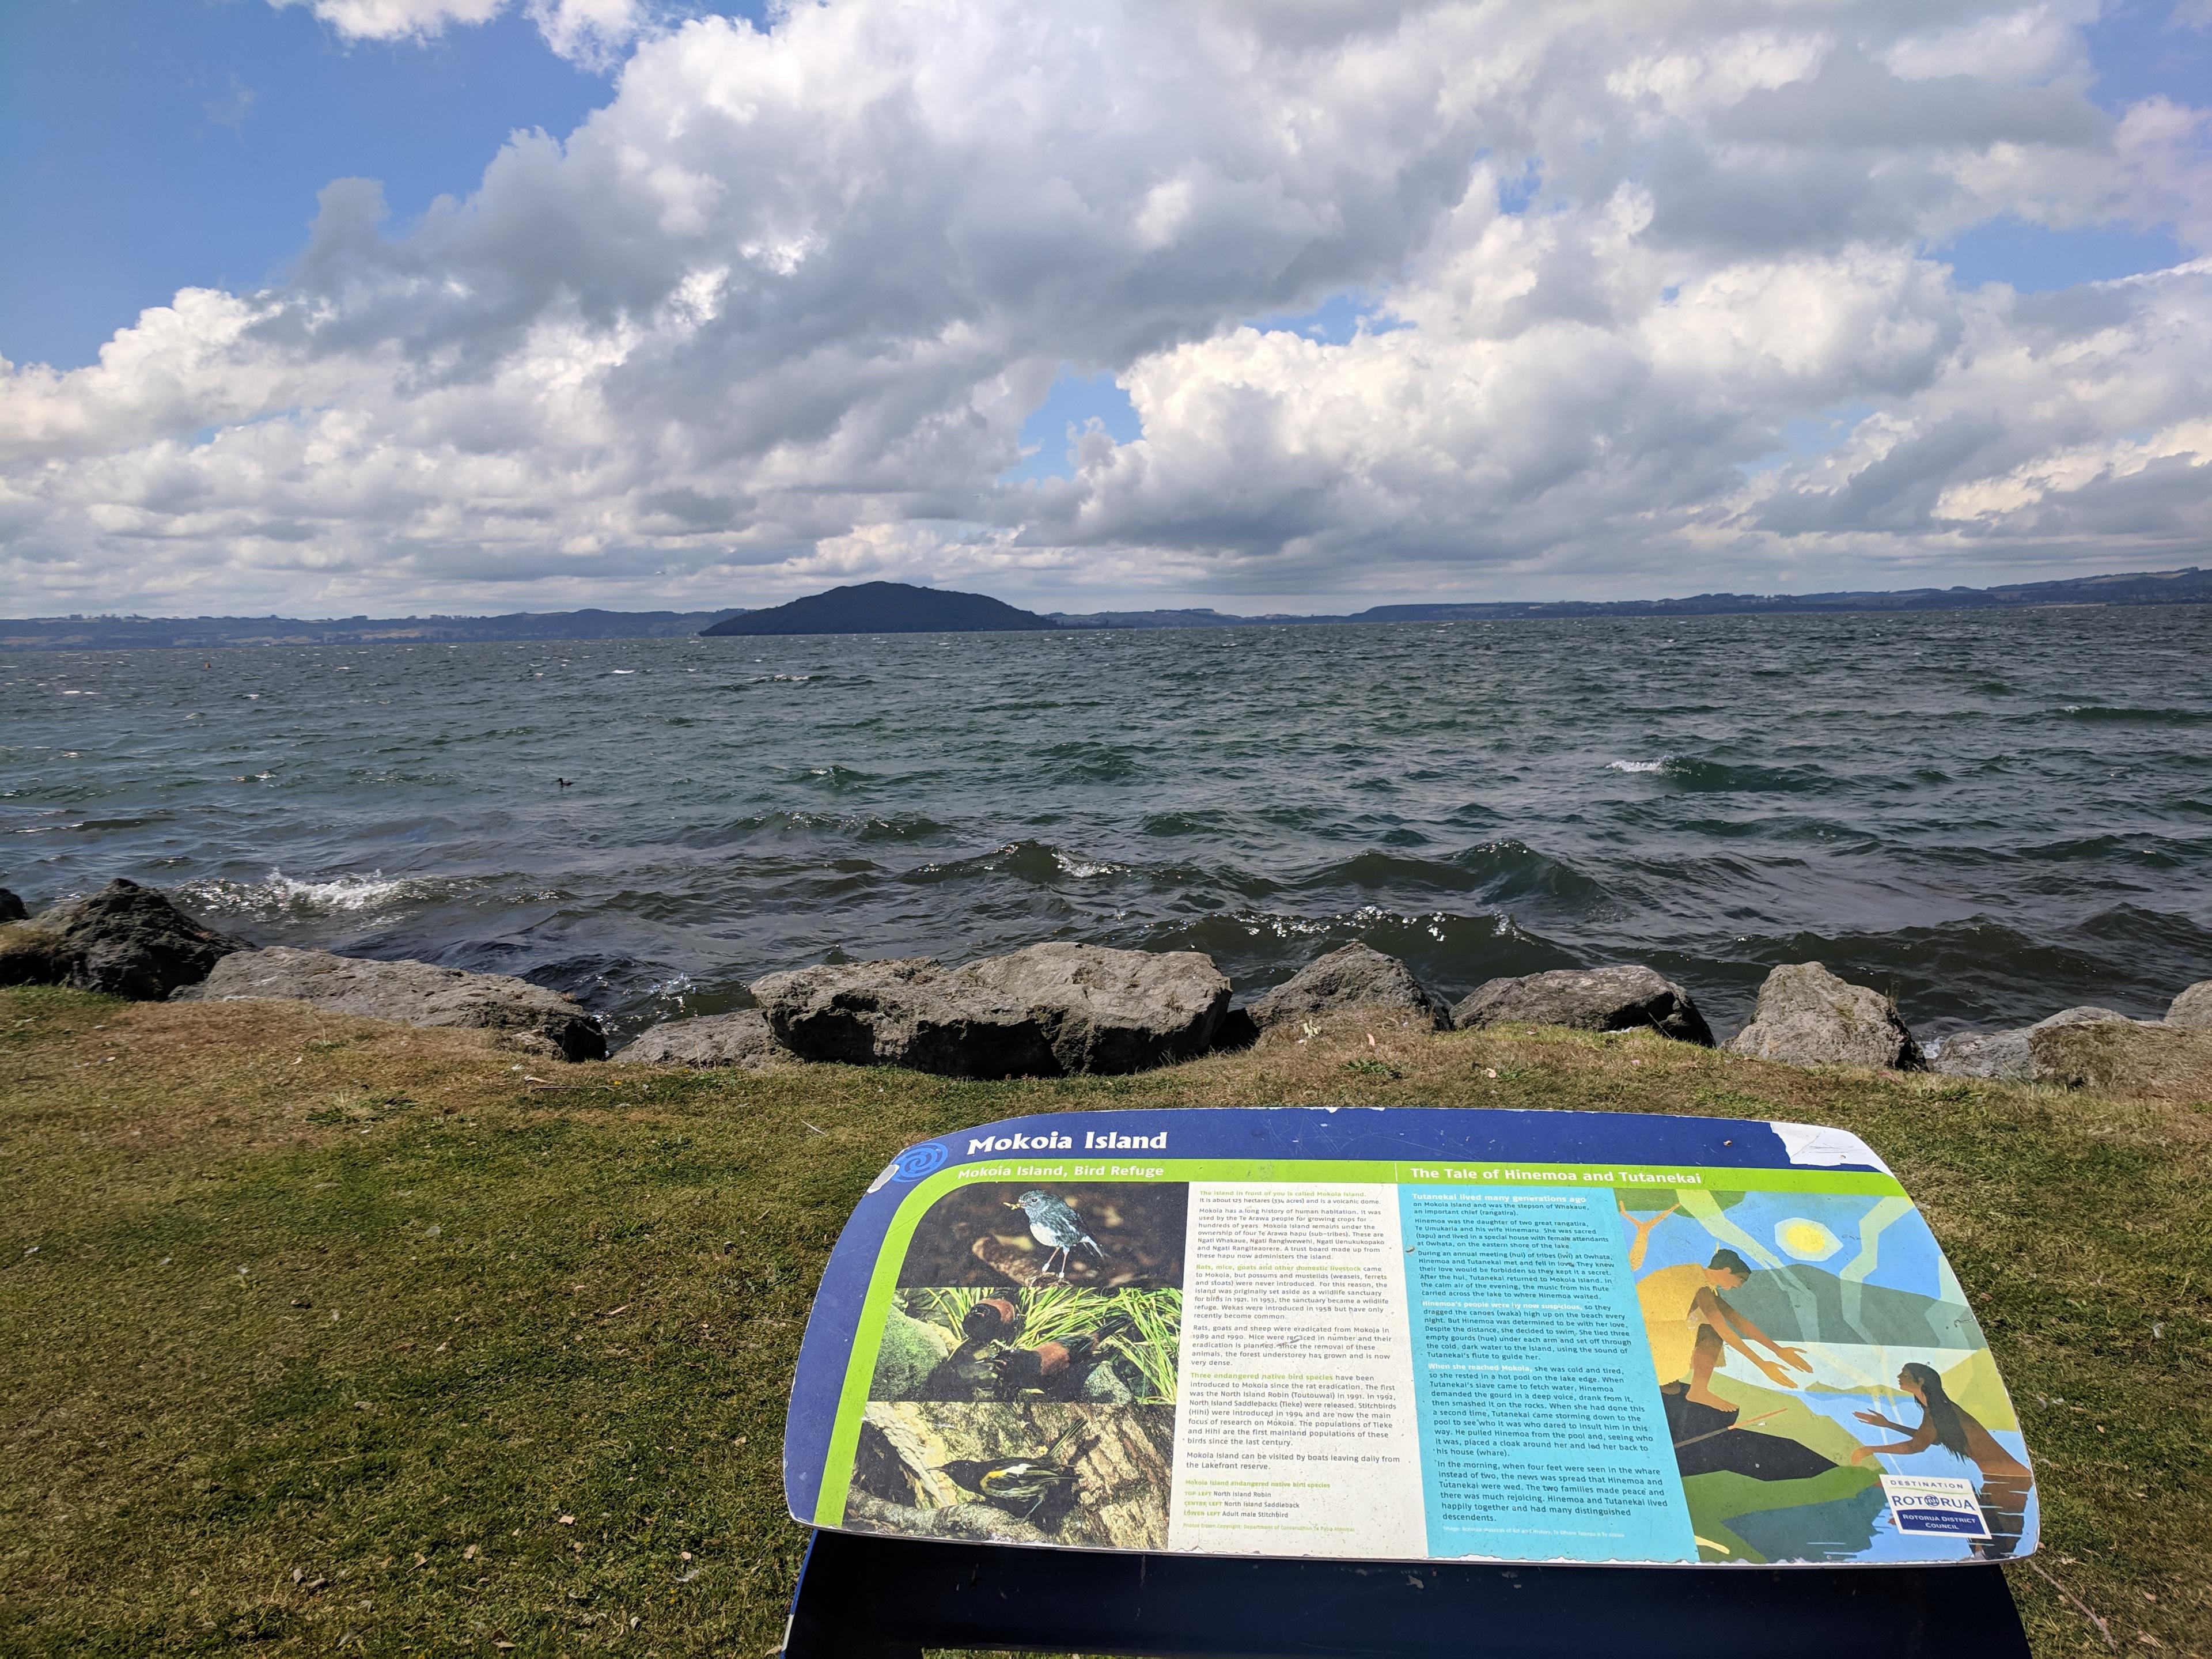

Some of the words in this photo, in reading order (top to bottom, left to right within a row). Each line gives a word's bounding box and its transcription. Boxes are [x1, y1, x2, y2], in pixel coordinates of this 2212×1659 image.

[967, 1131, 1071, 1156] Mokoia
[1085, 1131, 1168, 1149] Island
[957, 1166, 1012, 1179] Mokoia
[1017, 1166, 1068, 1178] Island,
[1074, 1166, 1105, 1176] Bird
[1111, 1166, 1164, 1178] Refuge
[1410, 1168, 1439, 1179] The
[1444, 1168, 1478, 1179] Tale
[1483, 1169, 1500, 1180] of
[1505, 1170, 1577, 1181] Hinemoa
[1582, 1171, 1614, 1182] and
[1619, 1172, 1702, 1184] Tutanekai
[1513, 1195, 1566, 1203] generations
[1890, 1480, 1964, 1489] DESTINATION
[1891, 1494, 1976, 1510] ROTORUA
[1574, 1508, 1631, 1516] distinguished
